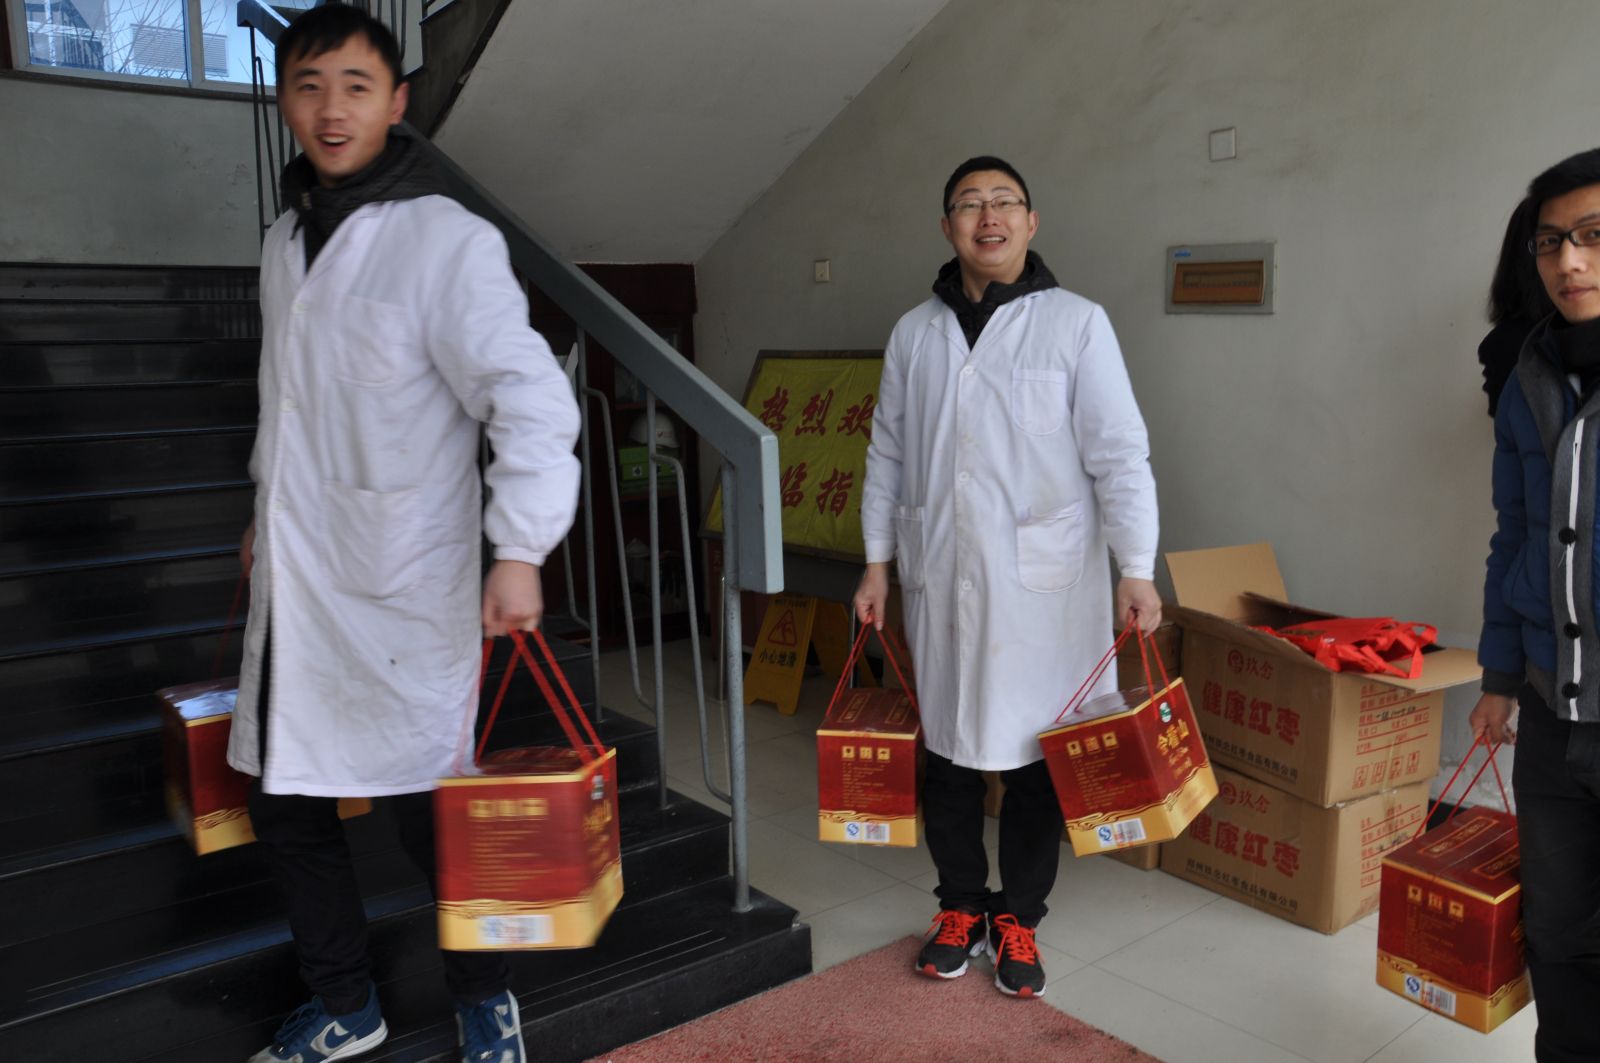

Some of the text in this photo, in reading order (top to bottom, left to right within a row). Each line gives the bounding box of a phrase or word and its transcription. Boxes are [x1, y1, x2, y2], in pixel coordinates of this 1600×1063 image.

[780, 462, 862, 518] 临指
[1203, 680, 1301, 746] 健康红枣
[1189, 812, 1301, 879] 健康红枣
